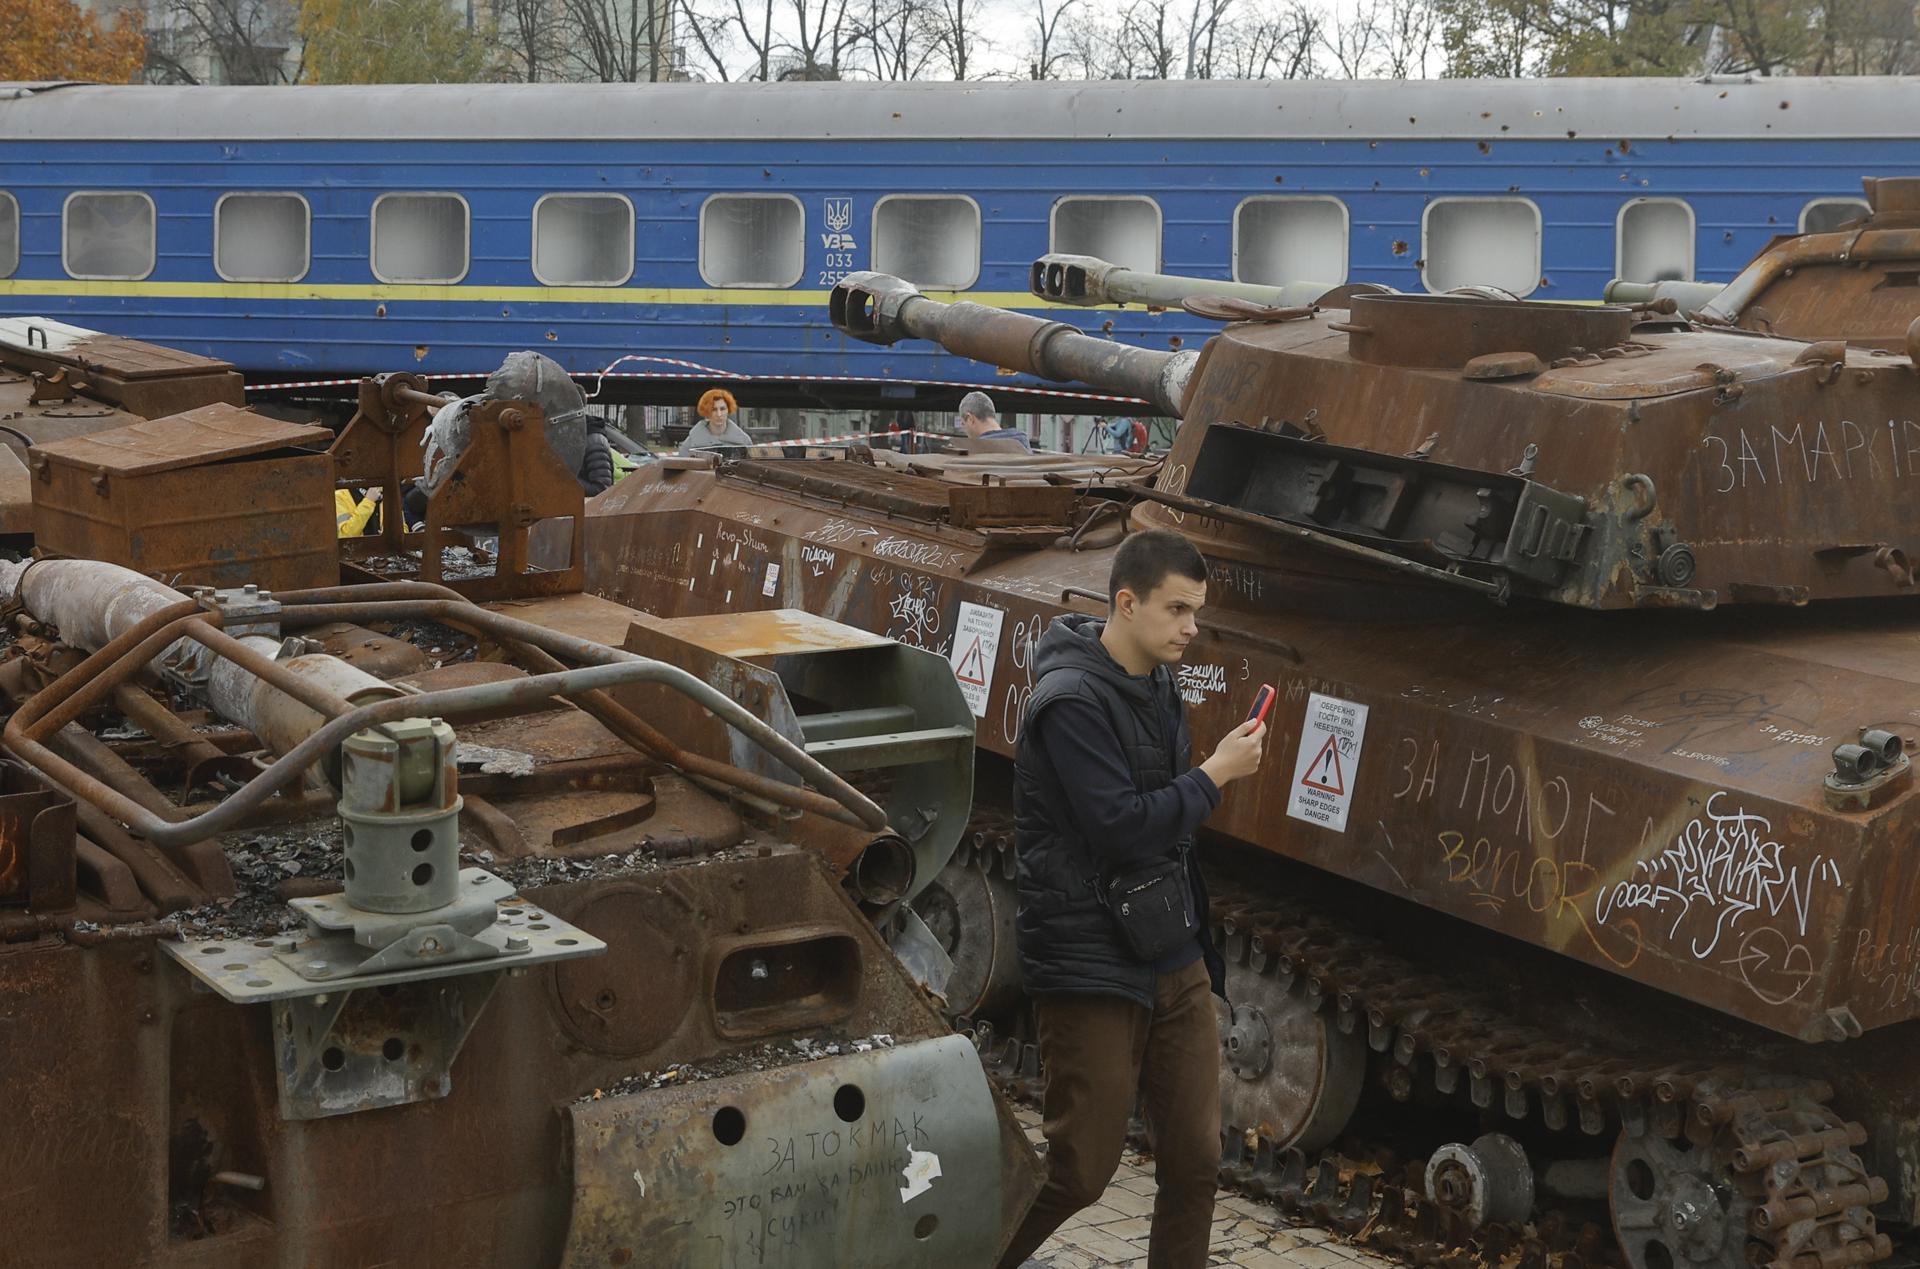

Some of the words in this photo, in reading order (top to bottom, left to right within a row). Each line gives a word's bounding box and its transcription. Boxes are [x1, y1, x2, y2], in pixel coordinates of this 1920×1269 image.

[826, 253, 853, 267] 033
[819, 271, 852, 286] 255
[1703, 427, 1766, 493] ЗА
[1321, 701, 1356, 717] ОБЕРЕЖНО
[1313, 720, 1355, 738] НЕБЕЗПЕЧНО
[1394, 737, 1440, 803] ЗА
[1307, 787, 1336, 802] WARNING
[1298, 795, 1319, 807] SHARP
[1320, 802, 1341, 815] EDGES
[1304, 808, 1330, 822] DANGER
[762, 1136, 796, 1176] ЗА
[805, 1111, 929, 1161] ТОКМАК
[723, 1193, 761, 1220] ЭТО
